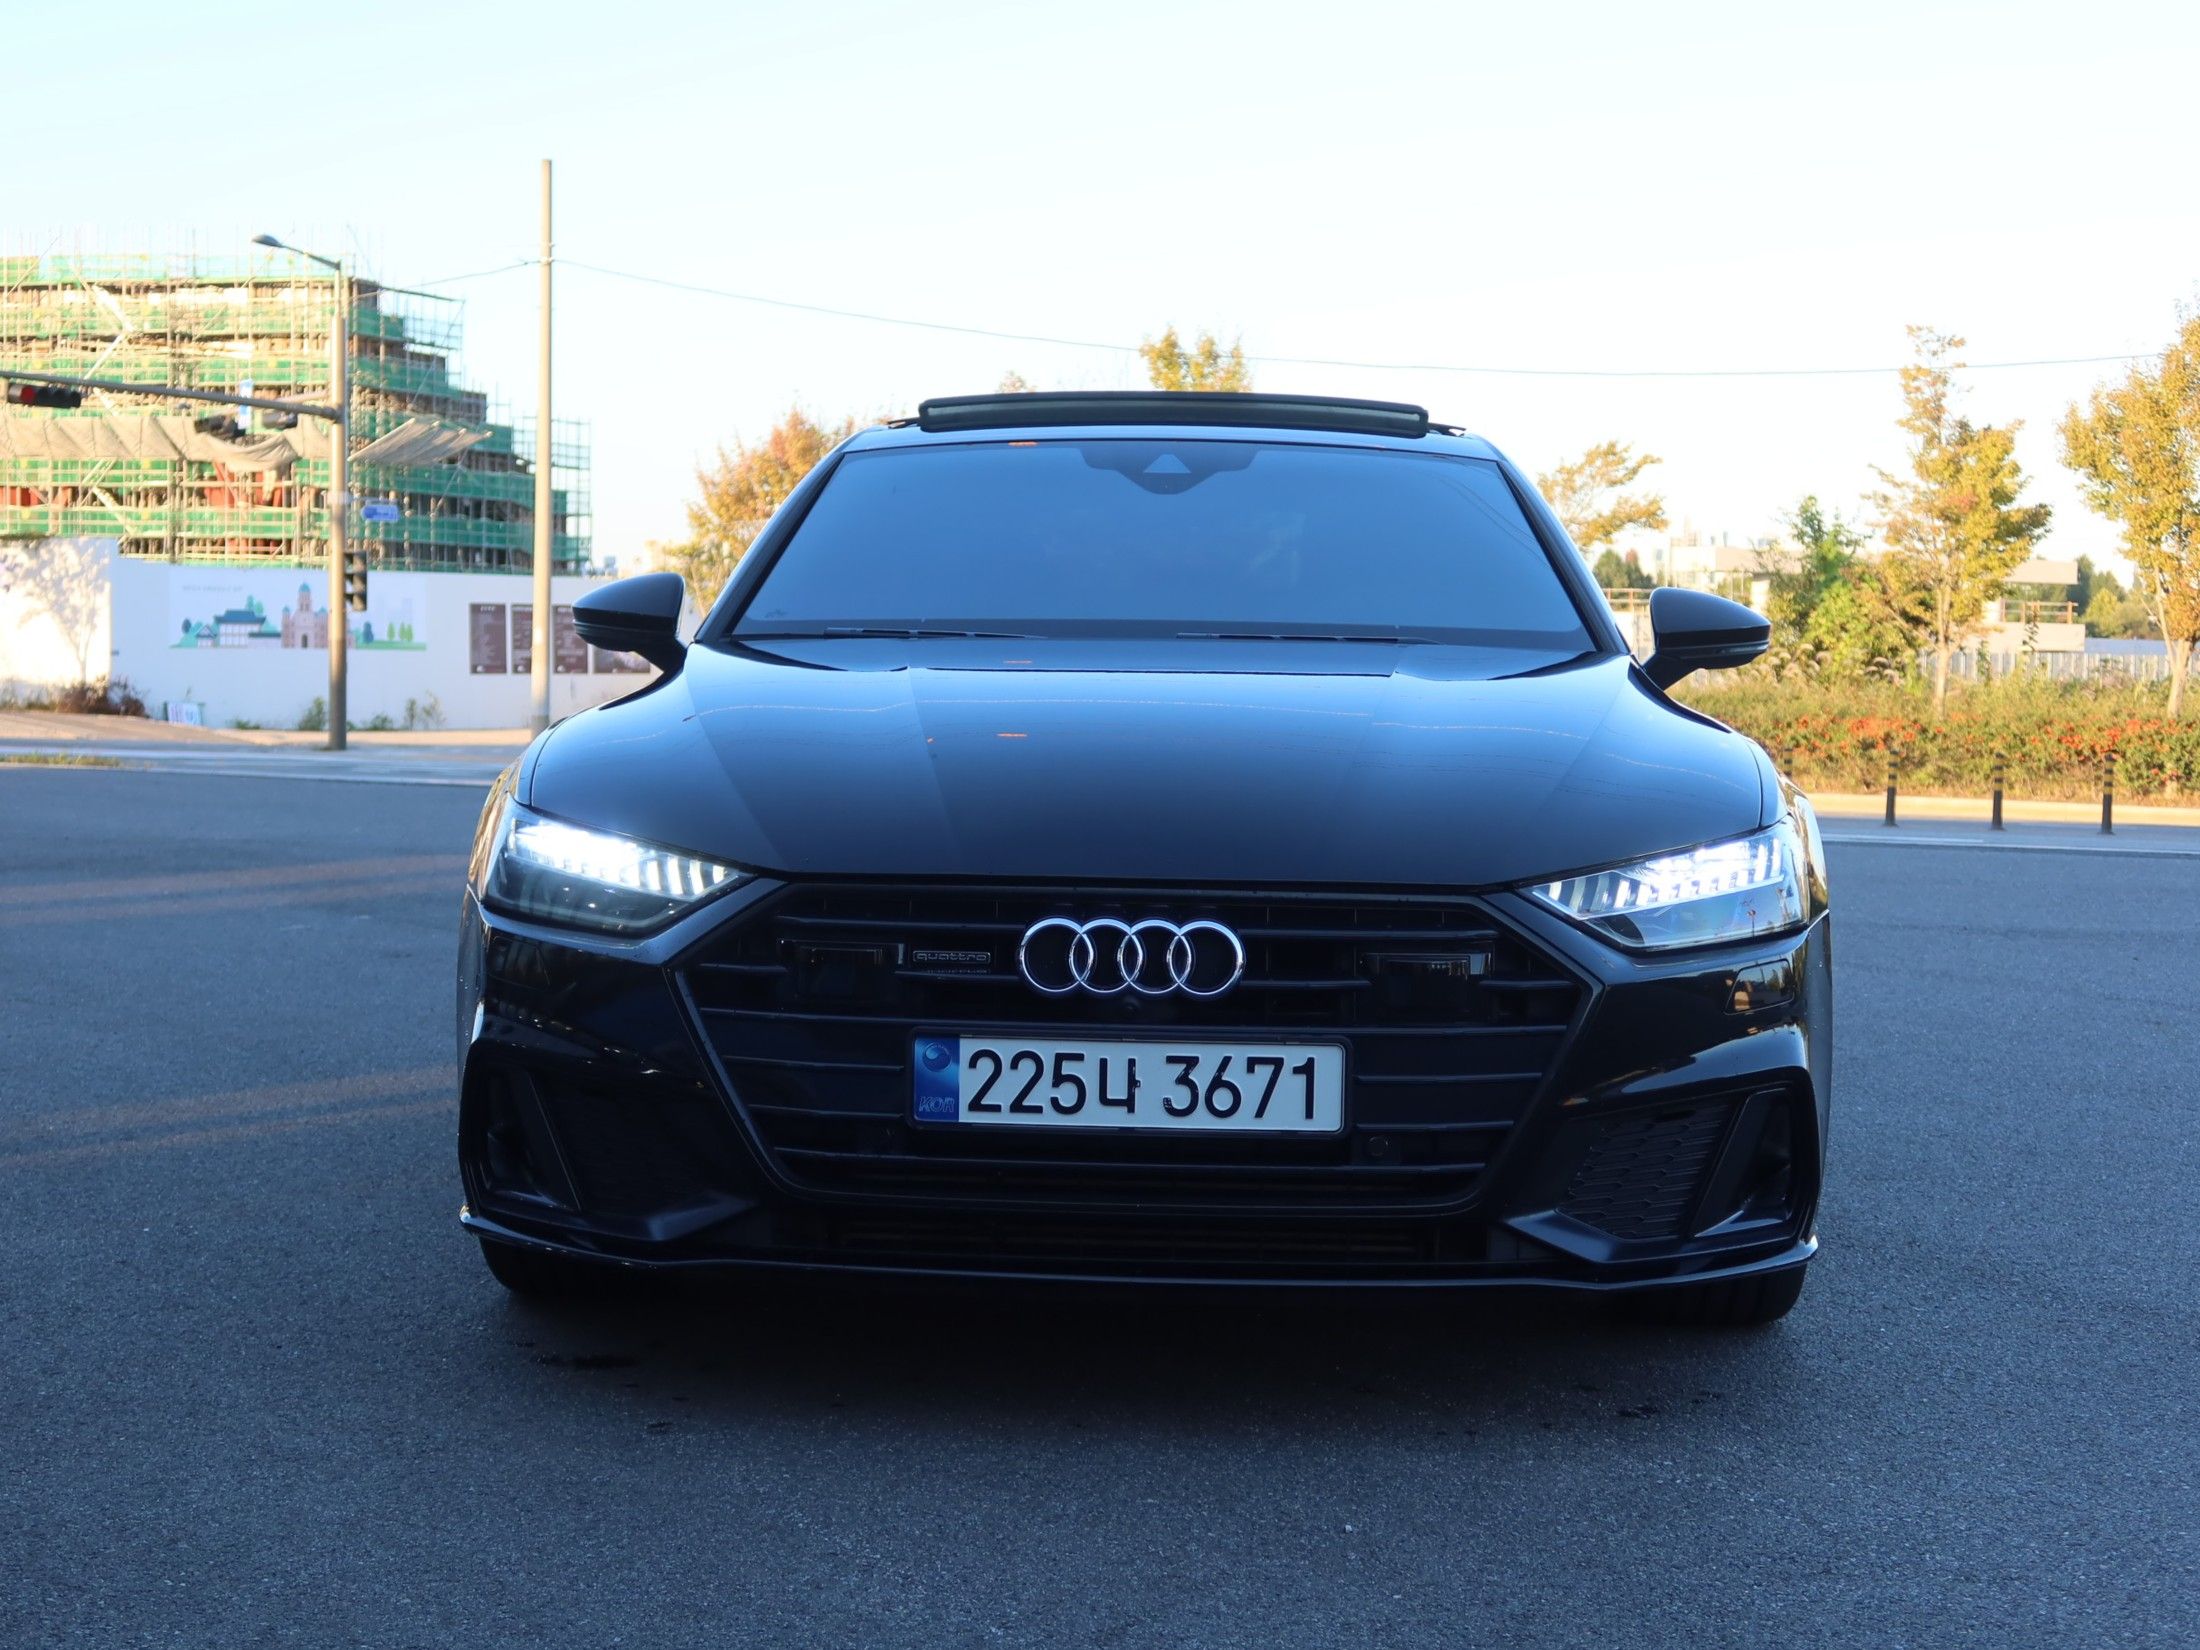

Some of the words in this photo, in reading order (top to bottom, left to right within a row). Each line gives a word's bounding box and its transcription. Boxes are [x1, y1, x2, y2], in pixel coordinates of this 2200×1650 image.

[915, 951, 987, 962] quattro
[967, 1048, 1141, 1115] 225나
[1162, 1055, 1316, 1120] 3671
[918, 1095, 956, 1113] KOR
